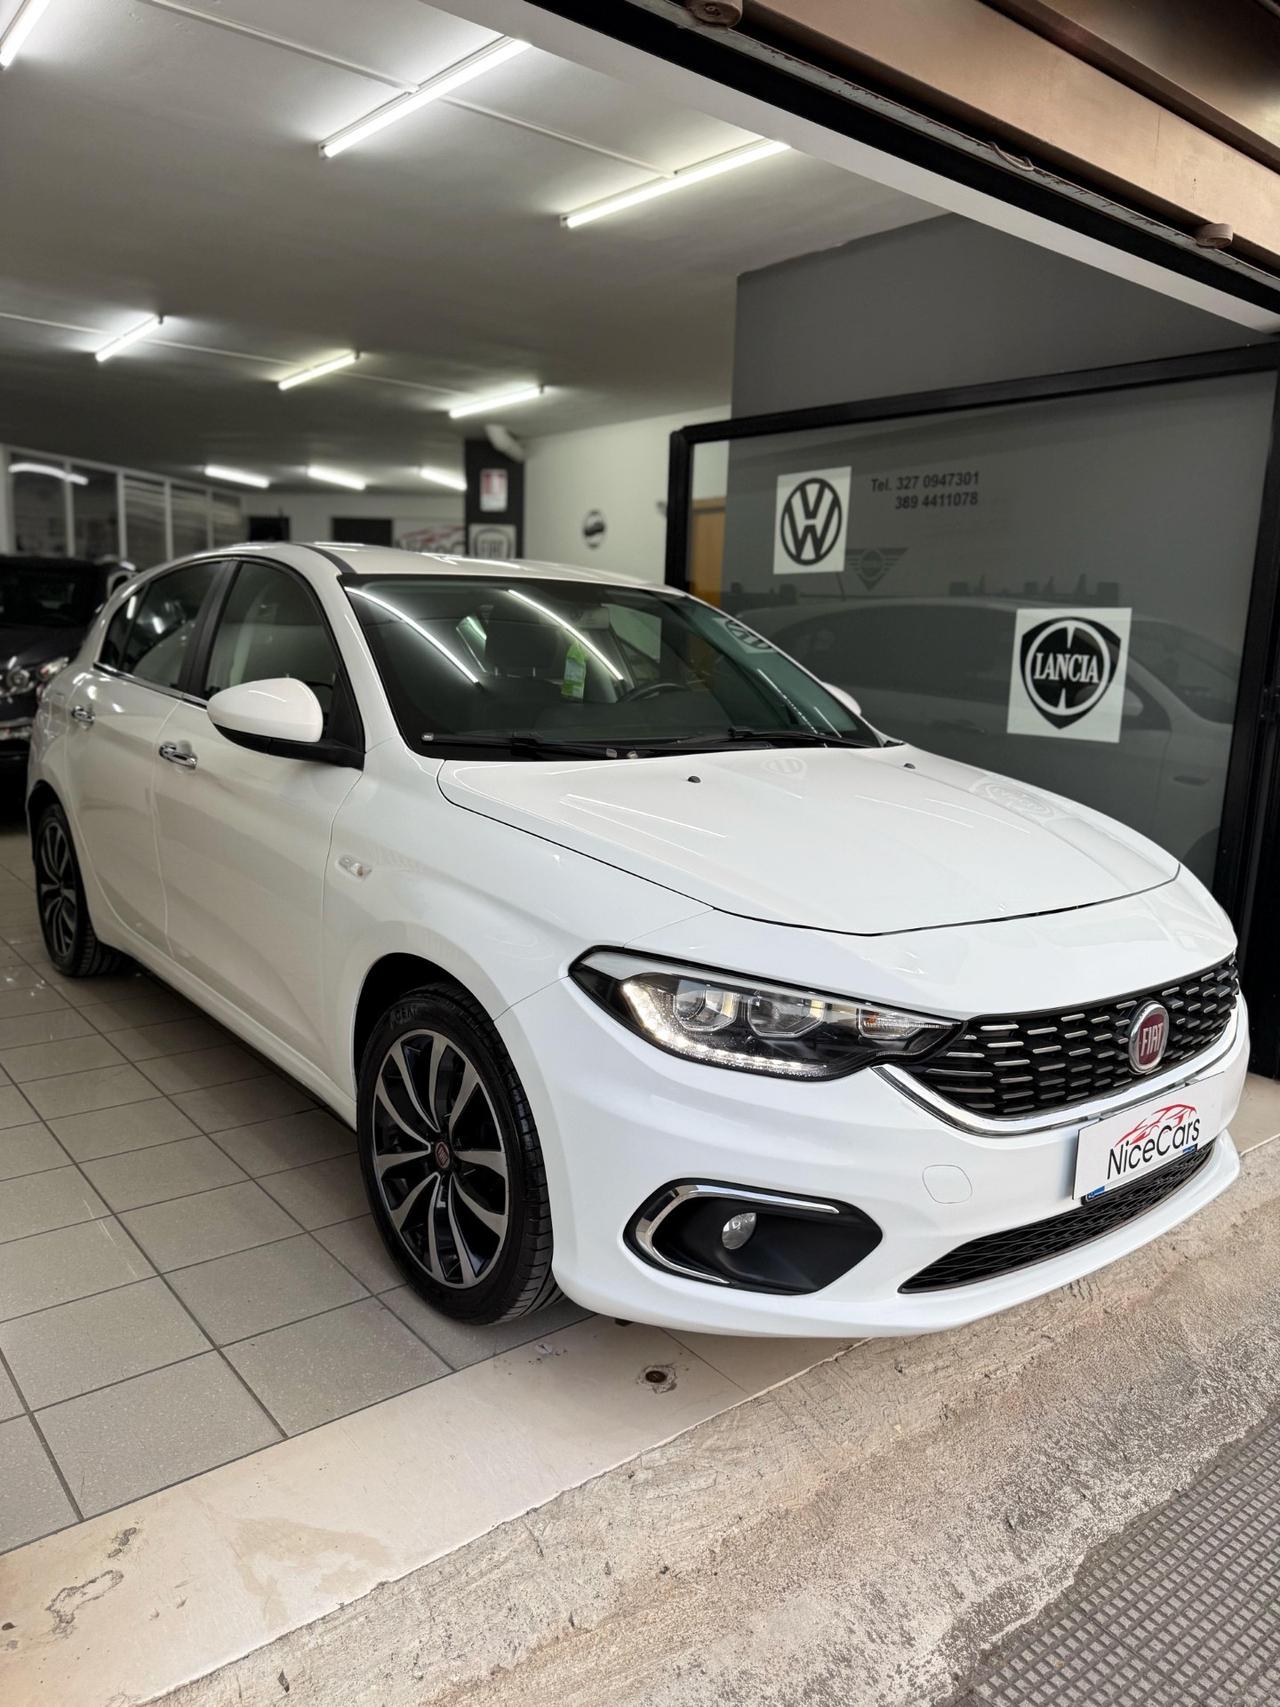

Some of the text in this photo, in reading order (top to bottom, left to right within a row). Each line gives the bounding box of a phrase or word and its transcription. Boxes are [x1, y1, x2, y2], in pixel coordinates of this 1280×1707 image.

[871, 470, 979, 492] Tel. 327 0947301
[922, 491, 979, 508] 4411078
[1034, 652, 1099, 683] LANCIA
[1141, 1022, 1164, 1057] FIAT
[1107, 1118, 1200, 1179] NiceCars
